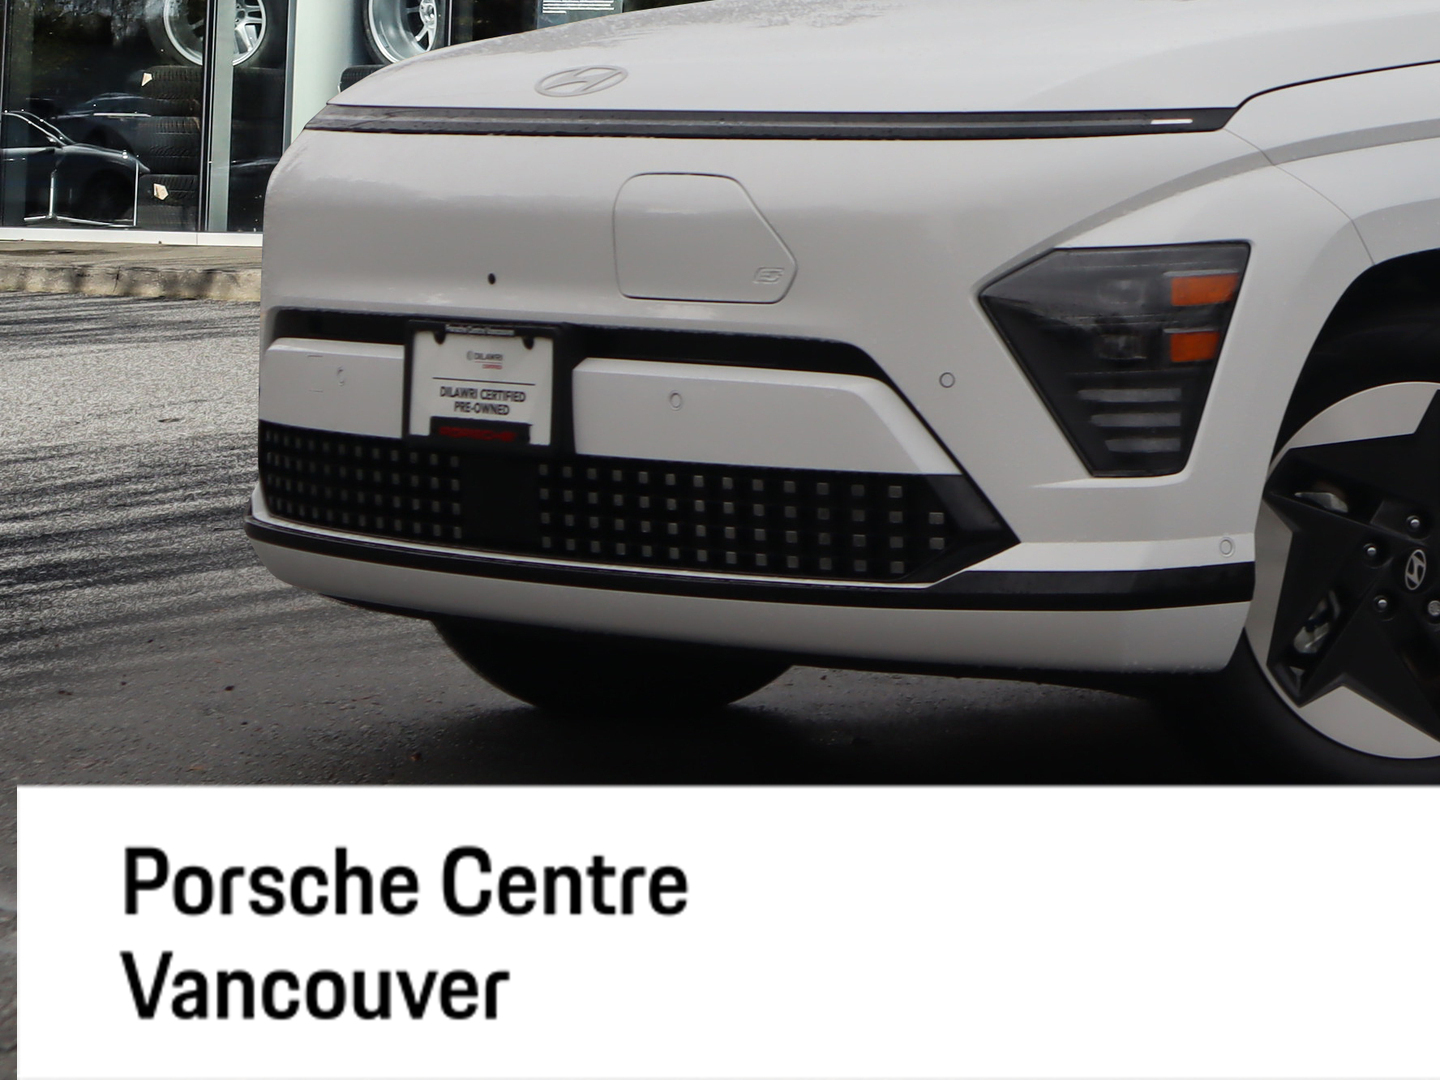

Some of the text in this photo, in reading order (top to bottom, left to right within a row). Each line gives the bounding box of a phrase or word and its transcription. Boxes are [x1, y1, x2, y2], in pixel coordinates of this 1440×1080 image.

[440, 386, 526, 403] DILAWRI CERTIFIED
[454, 401, 510, 416] PRE-OWNED
